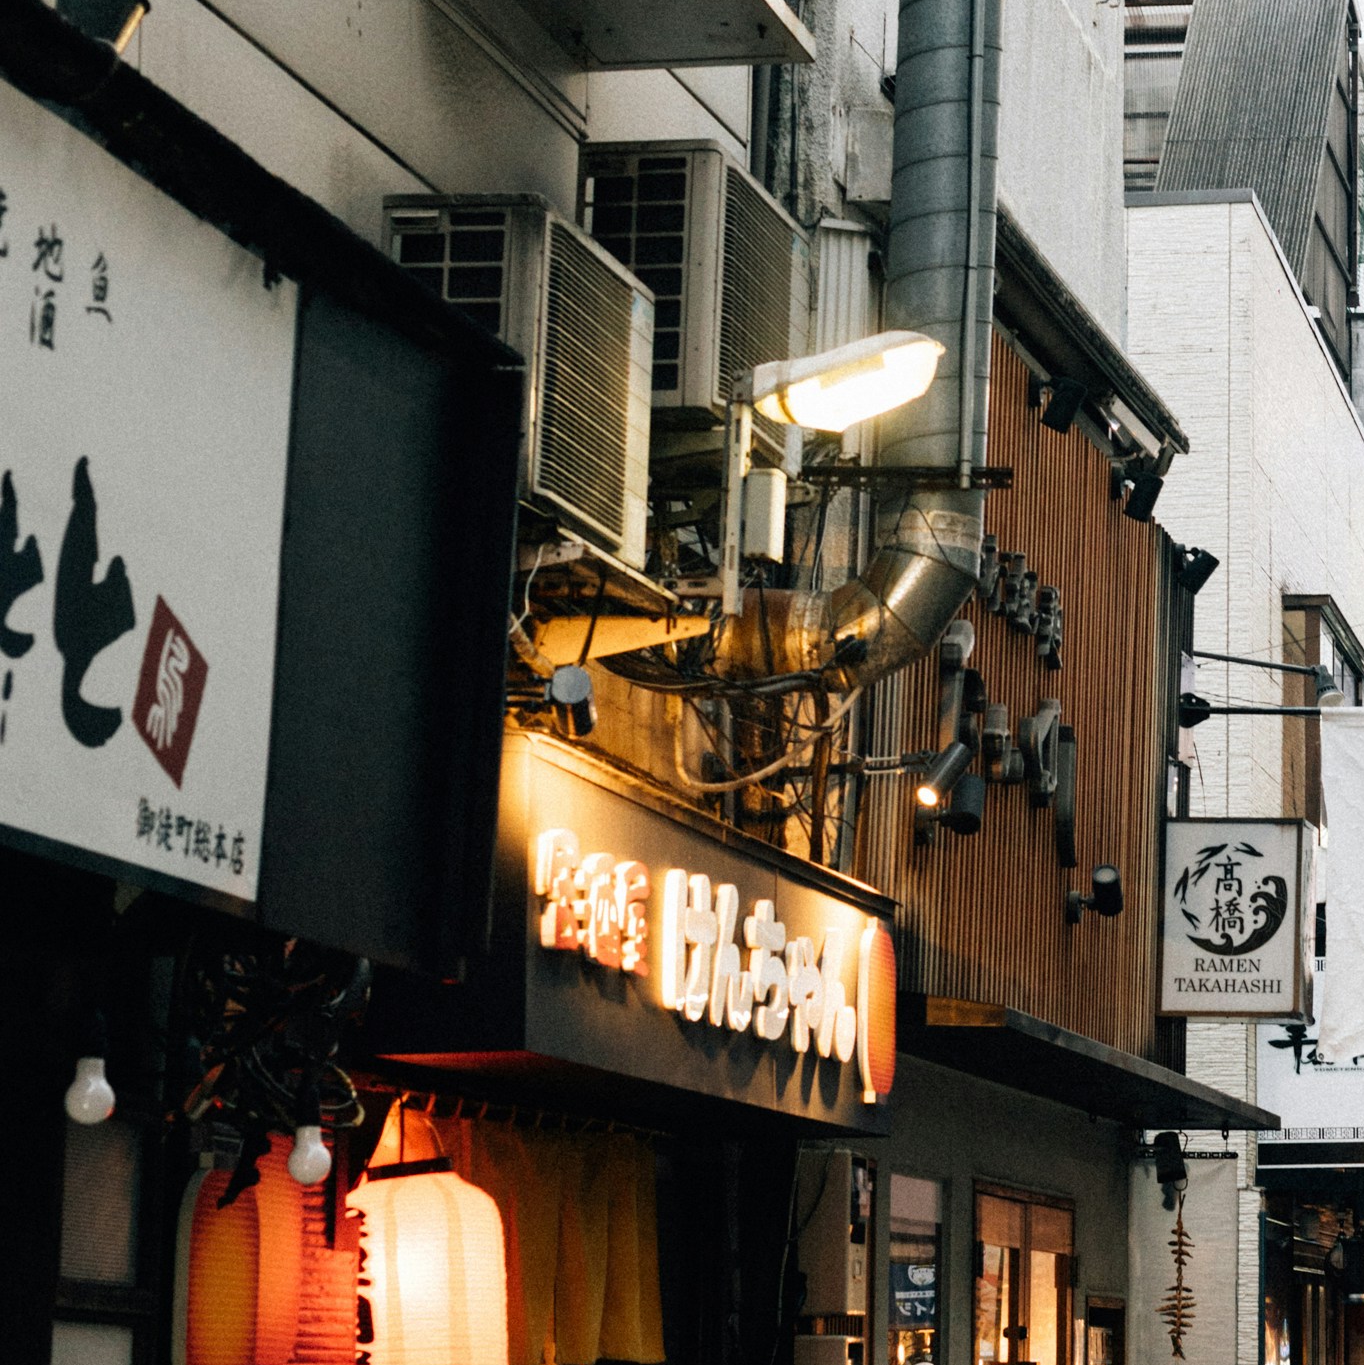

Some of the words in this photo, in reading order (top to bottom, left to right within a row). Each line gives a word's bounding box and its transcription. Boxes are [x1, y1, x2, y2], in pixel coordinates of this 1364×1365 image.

[660, 867, 857, 1064] けんちゃん
[1193, 957, 1262, 973] RAMEN
[1173, 977, 1283, 994] TAKAHASHI
